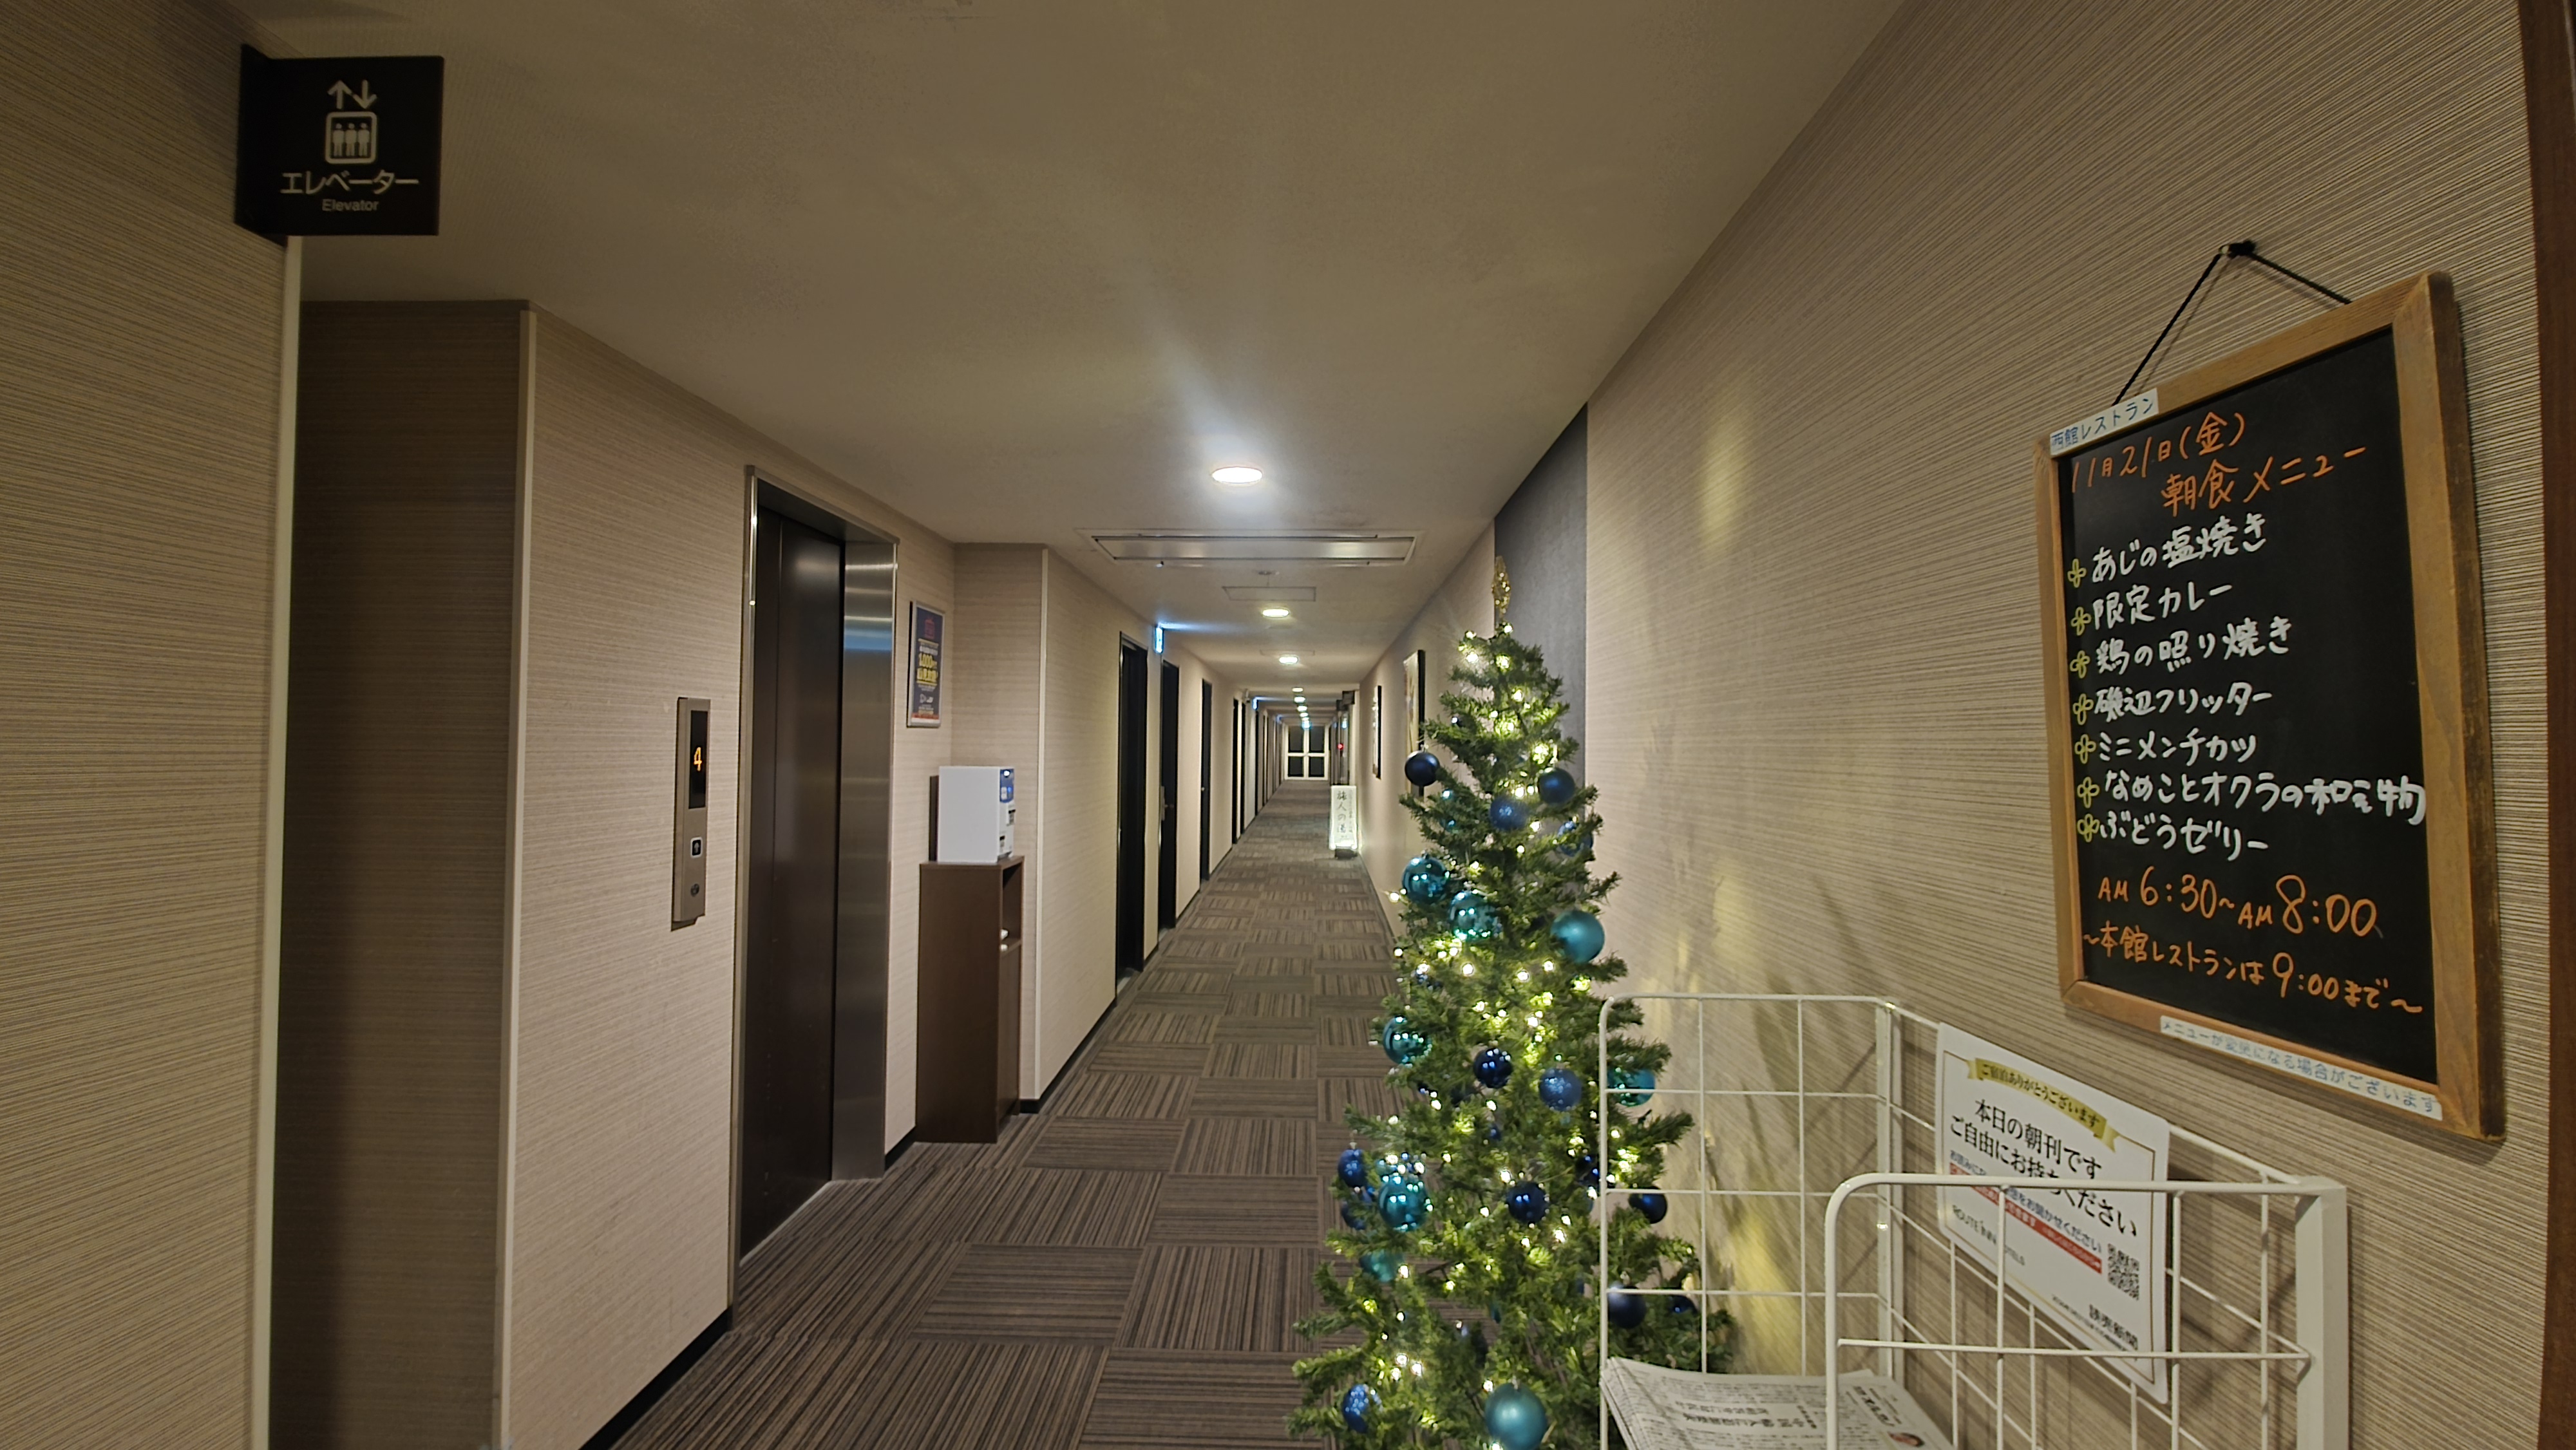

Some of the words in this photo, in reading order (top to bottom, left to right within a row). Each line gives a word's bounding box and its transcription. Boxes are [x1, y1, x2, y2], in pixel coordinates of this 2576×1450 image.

[280, 169, 419, 194] エレベーター
[321, 198, 379, 212] Elevator
[2051, 398, 2154, 450] 西館レストラン
[2072, 411, 2246, 493] 11月21日(金)
[2161, 446, 2367, 517] 朝食メニュー
[2091, 512, 2267, 583] あじの塩焼き
[2092, 580, 2233, 631] 限定カレー
[2095, 615, 2293, 675] 鶏の照り焼き
[2094, 681, 2273, 723] 磯辺フリッター
[693, 746, 703, 772] 4
[2098, 727, 2257, 767] ミニメンチカツ
[2104, 769, 2427, 826] なめことオクラの和え物
[2099, 810, 2269, 862] ぶどうゼリー
[1982, 1063, 2101, 1127] ご宿泊ありがとうございます
[1975, 1098, 2103, 1180] 本日の朝刊です
